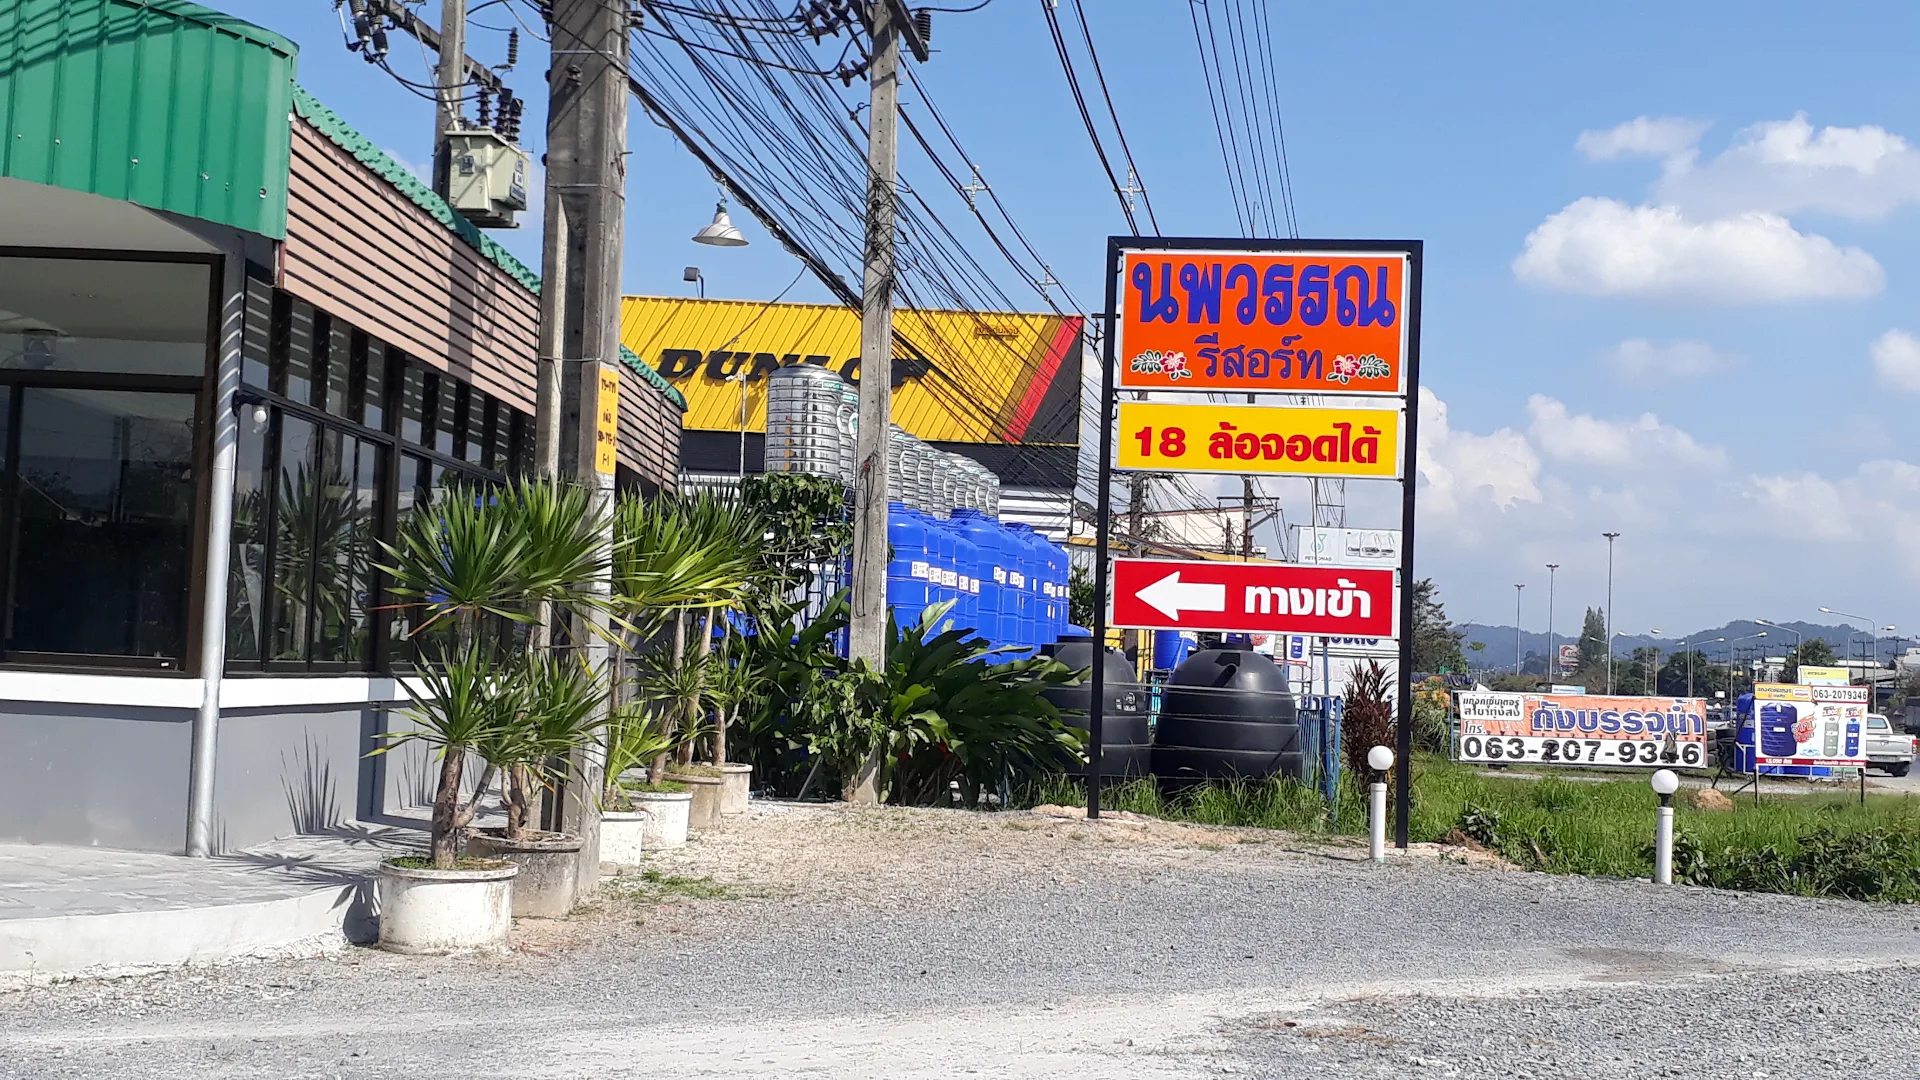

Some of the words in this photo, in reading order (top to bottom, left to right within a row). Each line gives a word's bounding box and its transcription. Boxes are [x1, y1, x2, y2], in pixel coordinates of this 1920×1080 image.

[1132, 261, 1396, 328] นพวรรณ
[1193, 331, 1323, 380] รีสอร์ท
[1134, 426, 1186, 457] 18
[1208, 420, 1383, 465] ล้อจอดได้
[1243, 577, 1372, 618] ทางเข้า
[1813, 689, 1867, 700] 063-2079346
[1464, 720, 1486, 735] โทร.
[1531, 698, 1703, 740] ถังบรรจุน้ำ
